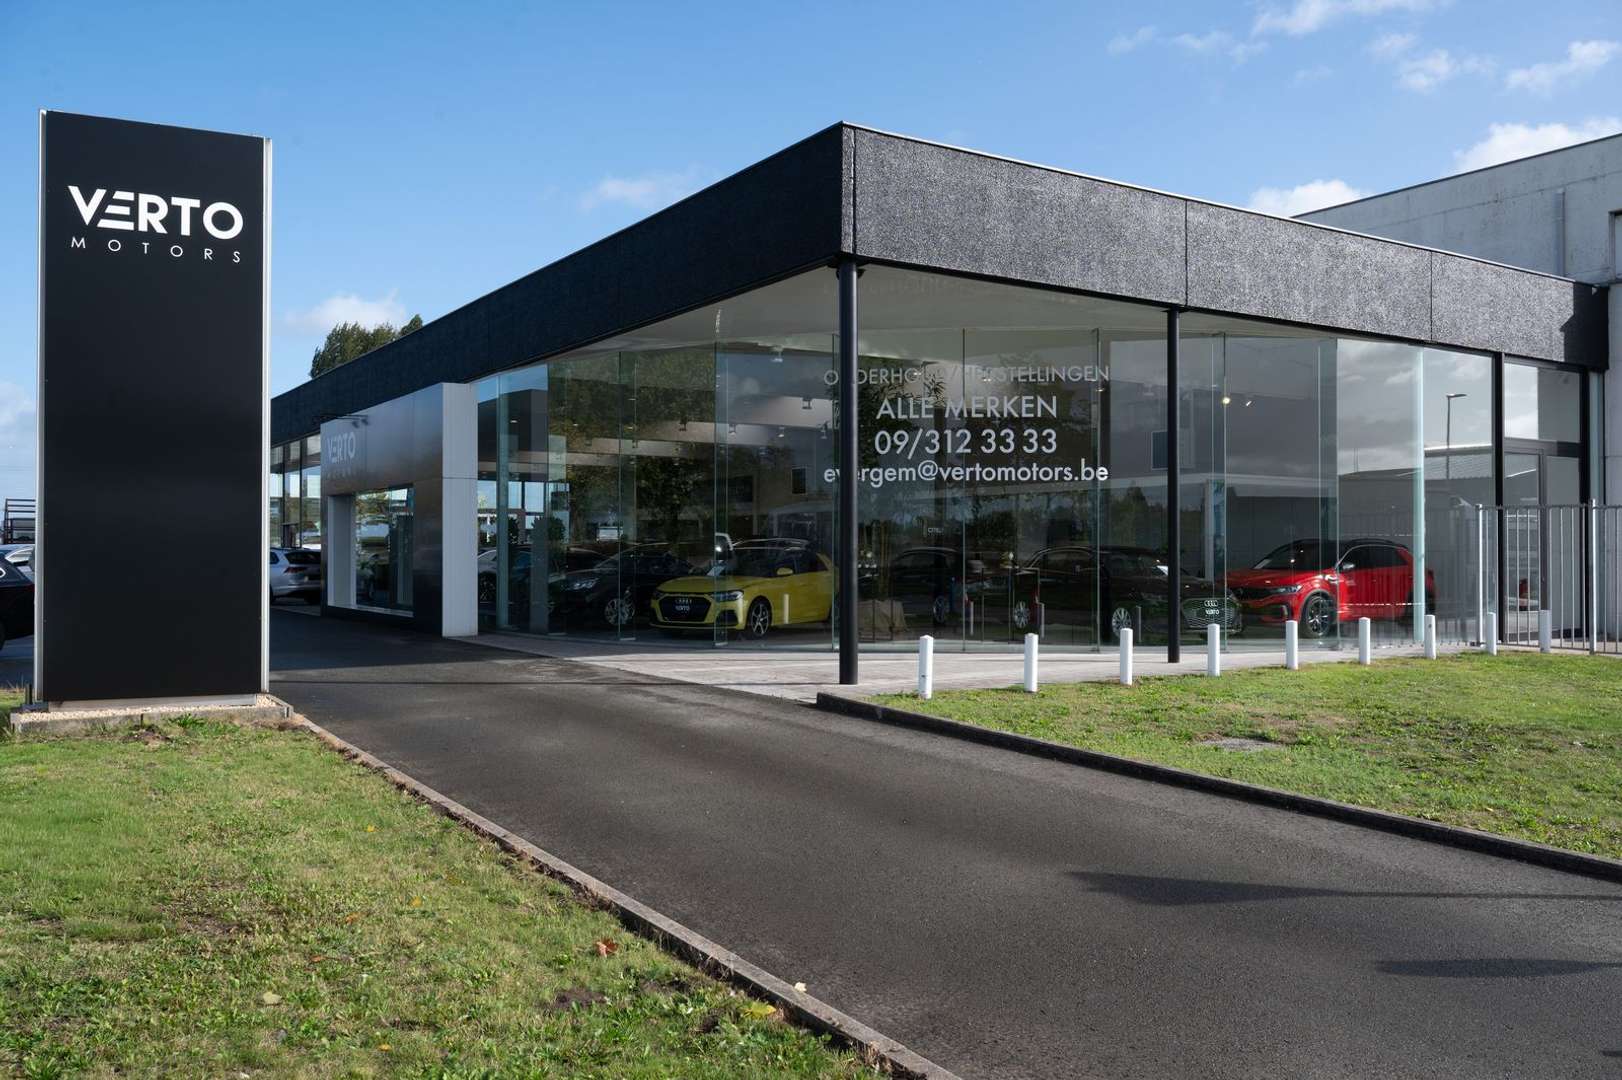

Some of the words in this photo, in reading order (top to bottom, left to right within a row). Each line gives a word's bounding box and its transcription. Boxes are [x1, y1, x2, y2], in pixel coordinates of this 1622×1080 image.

[67, 185, 244, 240] VERTO
[70, 236, 241, 263] MOTORS
[876, 396, 934, 419] ALLE
[944, 395, 1057, 419] MERKEN
[326, 431, 356, 463] VERTO
[874, 428, 971, 458] 09/312
[981, 429, 1015, 454] 33
[1023, 429, 1057, 454] 33
[823, 459, 1109, 488] ergem@vertomotors.be
